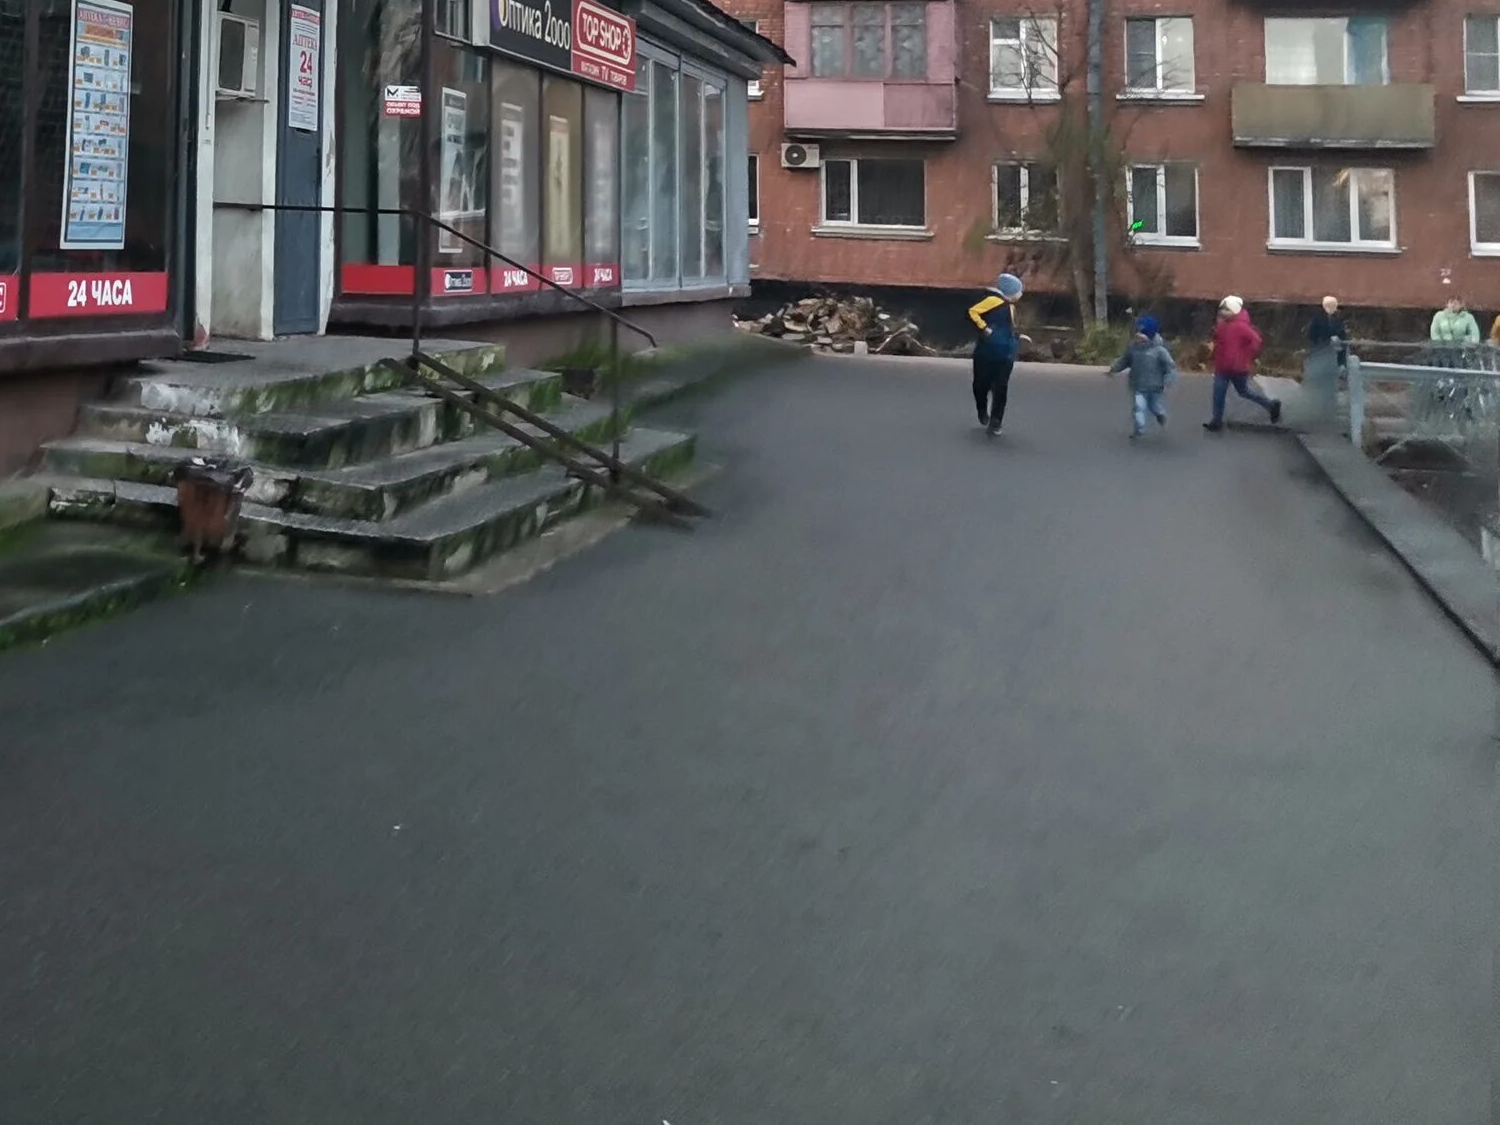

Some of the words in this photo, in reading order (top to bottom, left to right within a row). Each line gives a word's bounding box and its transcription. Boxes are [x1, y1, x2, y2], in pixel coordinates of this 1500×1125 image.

[544, 0, 571, 51] 2000
[582, 12, 599, 45] TOP
[599, 19, 622, 52] SHOP
[300, 50, 313, 75] 24
[67, 280, 87, 307] 24
[91, 278, 133, 306] ЧАСА
